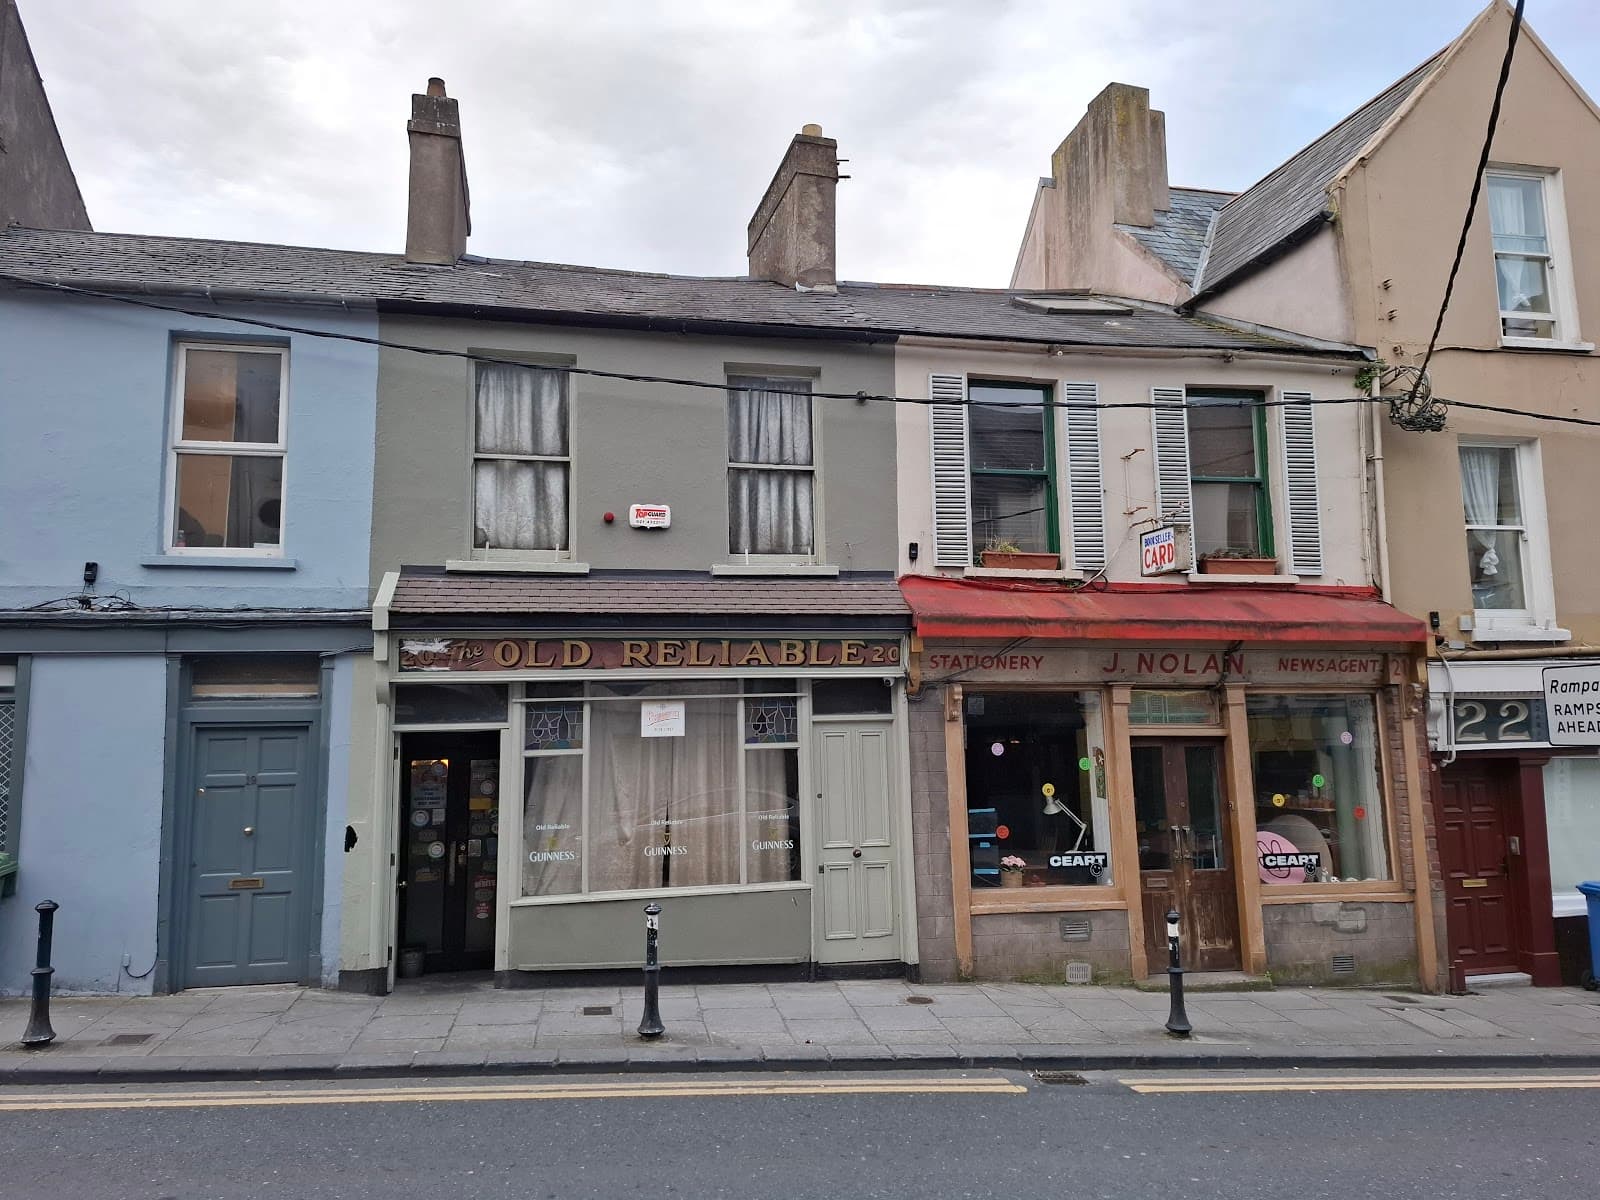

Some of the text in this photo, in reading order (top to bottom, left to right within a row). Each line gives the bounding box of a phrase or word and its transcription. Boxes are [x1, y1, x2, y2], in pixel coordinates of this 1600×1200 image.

[1144, 543, 1174, 569] CARD
[449, 641, 484, 661] The
[493, 640, 593, 668] OLD
[621, 639, 867, 667] RELIABLE
[871, 646, 900, 662] 20
[929, 655, 1045, 670] STATIONERY
[1137, 652, 1244, 674] NOLAN
[1278, 657, 1379, 673] NEWSAGENT
[1554, 702, 1600, 716] RAMPS
[1456, 701, 1532, 741] 22
[644, 846, 688, 857] GUINNESS
[752, 839, 794, 851] GUINNESS
[529, 851, 575, 862] GUINNESS
[1049, 855, 1106, 867] CEART
[1265, 855, 1319, 867] CEART
